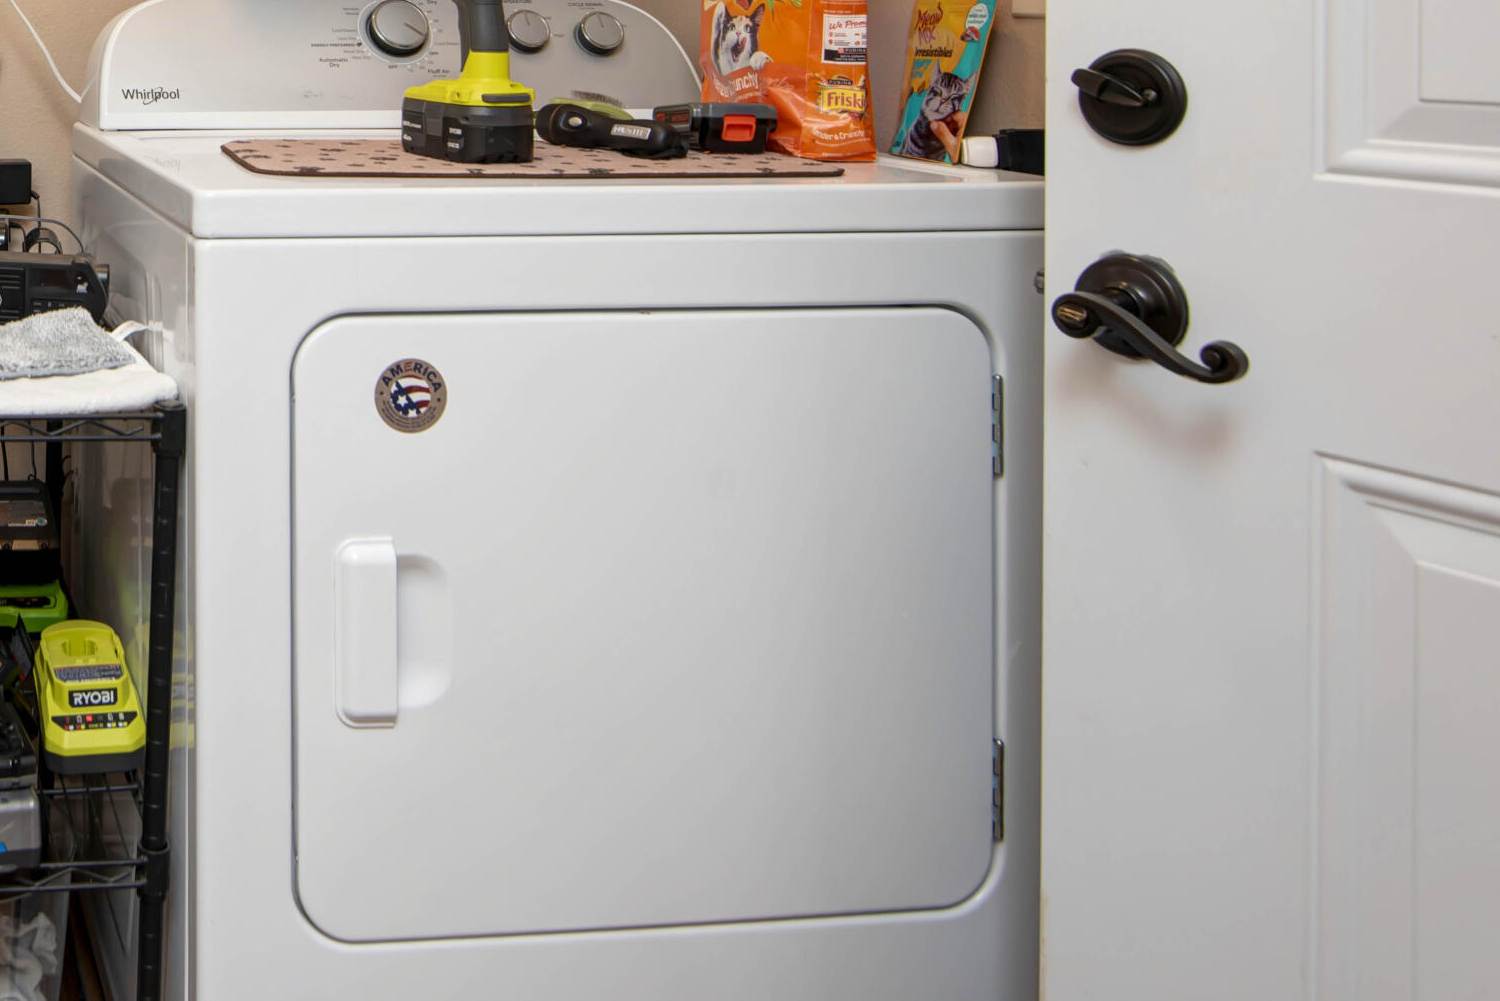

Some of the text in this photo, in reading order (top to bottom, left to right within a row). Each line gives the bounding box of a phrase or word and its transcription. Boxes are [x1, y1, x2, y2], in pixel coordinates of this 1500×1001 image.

[914, 2, 943, 31] Meow
[915, 47, 953, 58] Irresistibles
[121, 87, 180, 104] Whirlpool
[382, 361, 442, 392] AMERICA
[73, 690, 115, 706] RYOBI
